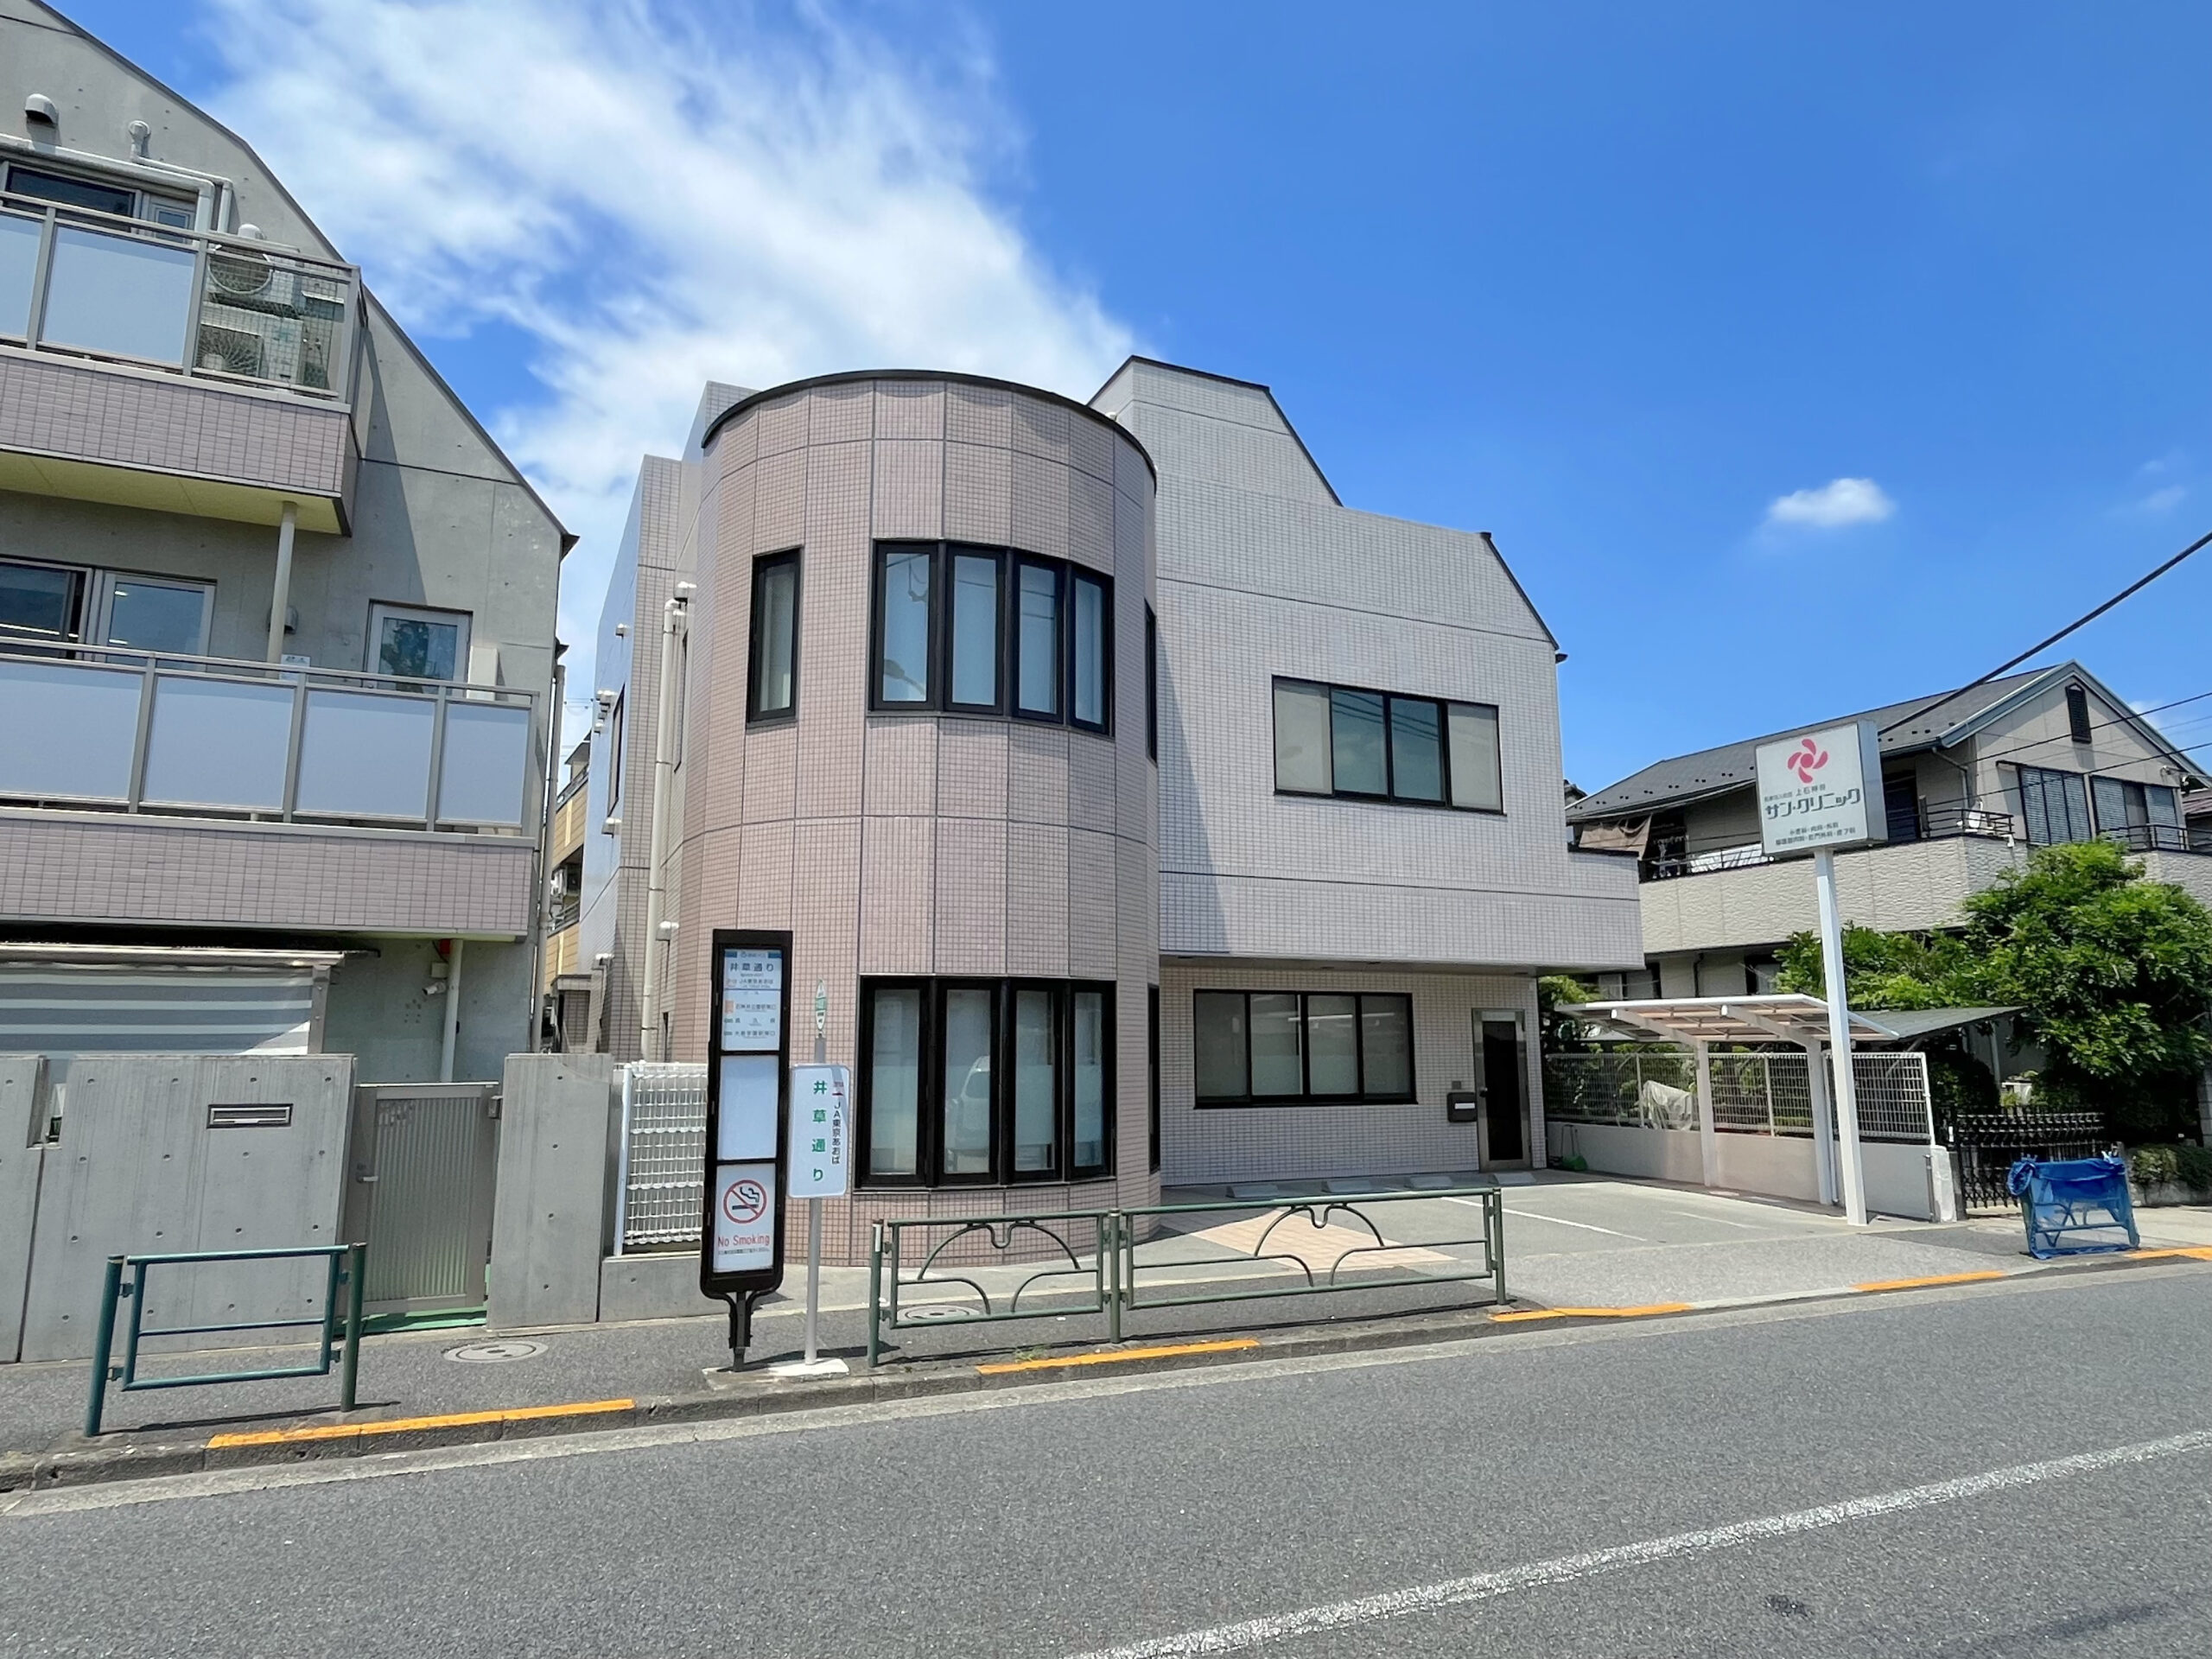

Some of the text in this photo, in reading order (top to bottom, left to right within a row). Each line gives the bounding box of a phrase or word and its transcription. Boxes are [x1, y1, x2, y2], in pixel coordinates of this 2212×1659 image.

[730, 963, 774, 972] 井草通り
[811, 1080, 827, 1181] 井草通り
[831, 1101, 842, 1164] JA東京あおば
[718, 1234, 770, 1247] No Smoking
